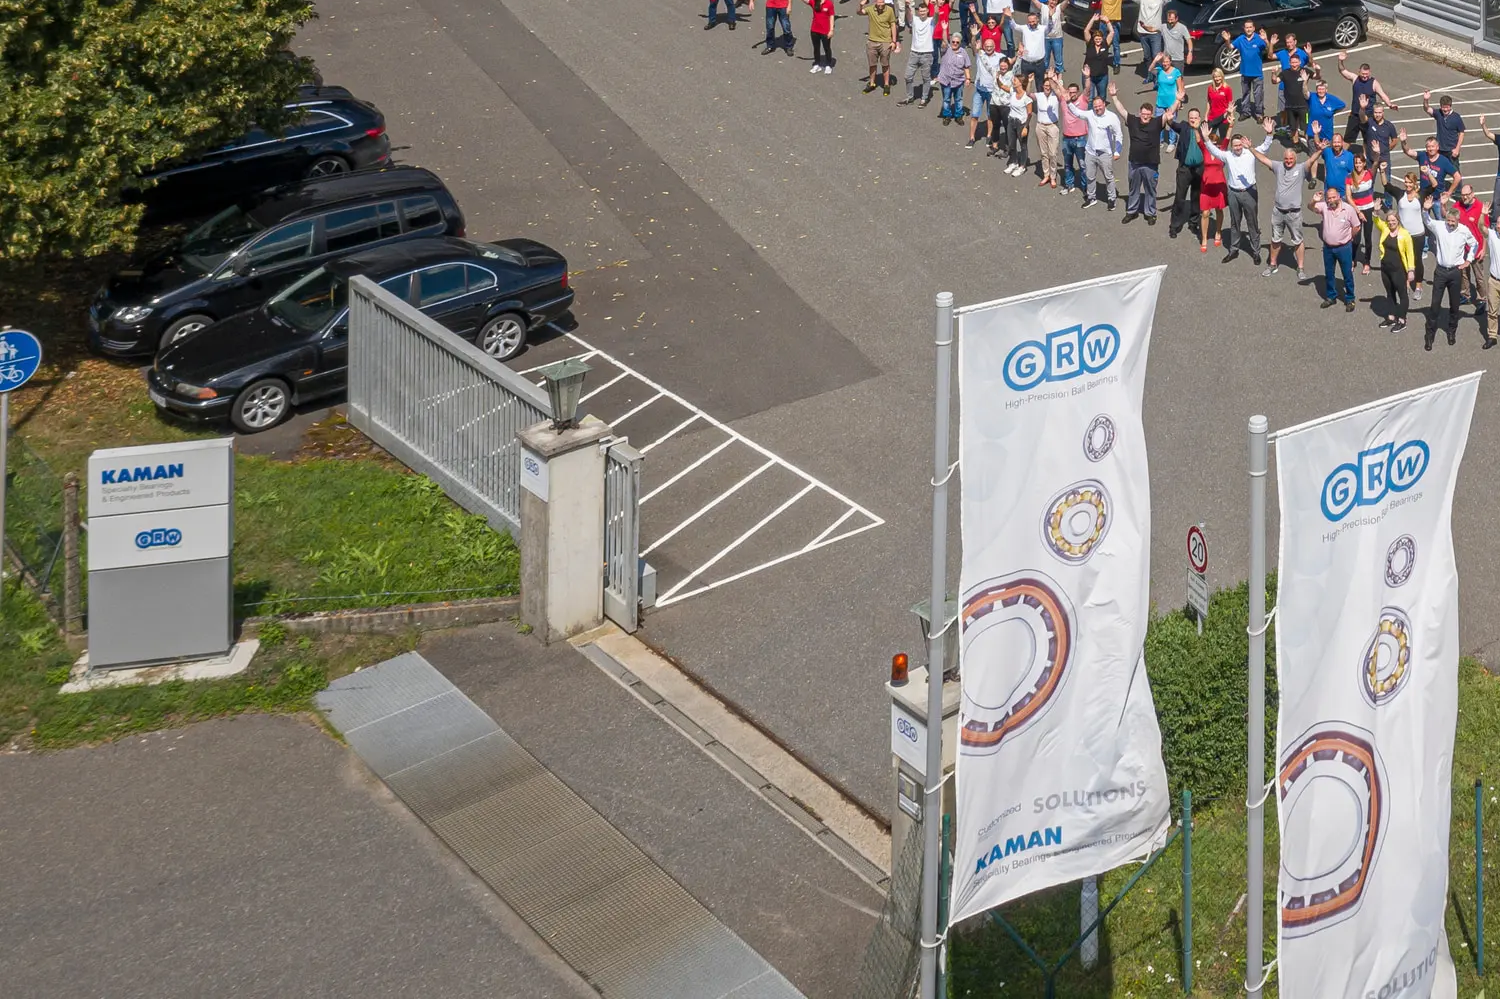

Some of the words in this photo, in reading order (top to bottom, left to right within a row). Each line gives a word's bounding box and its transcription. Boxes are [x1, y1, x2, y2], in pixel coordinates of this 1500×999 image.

[1011, 332, 1114, 383] GRW
[1005, 390, 1069, 410] High-Precision
[1071, 383, 1086, 396] Ball
[1087, 374, 1119, 390] Bearings
[101, 463, 184, 485] KAMAN
[101, 484, 137, 495] Specialty
[1328, 450, 1424, 511] GRW
[156, 488, 191, 498] Products
[1322, 515, 1382, 543] High-Precision
[1389, 491, 1423, 511] Bearings
[1191, 536, 1204, 563] 20
[1032, 780, 1147, 814] SOLUTIONS
[977, 803, 1022, 836] Customized
[975, 826, 1062, 874] KAMAN
[1012, 852, 1051, 870] Bearings
